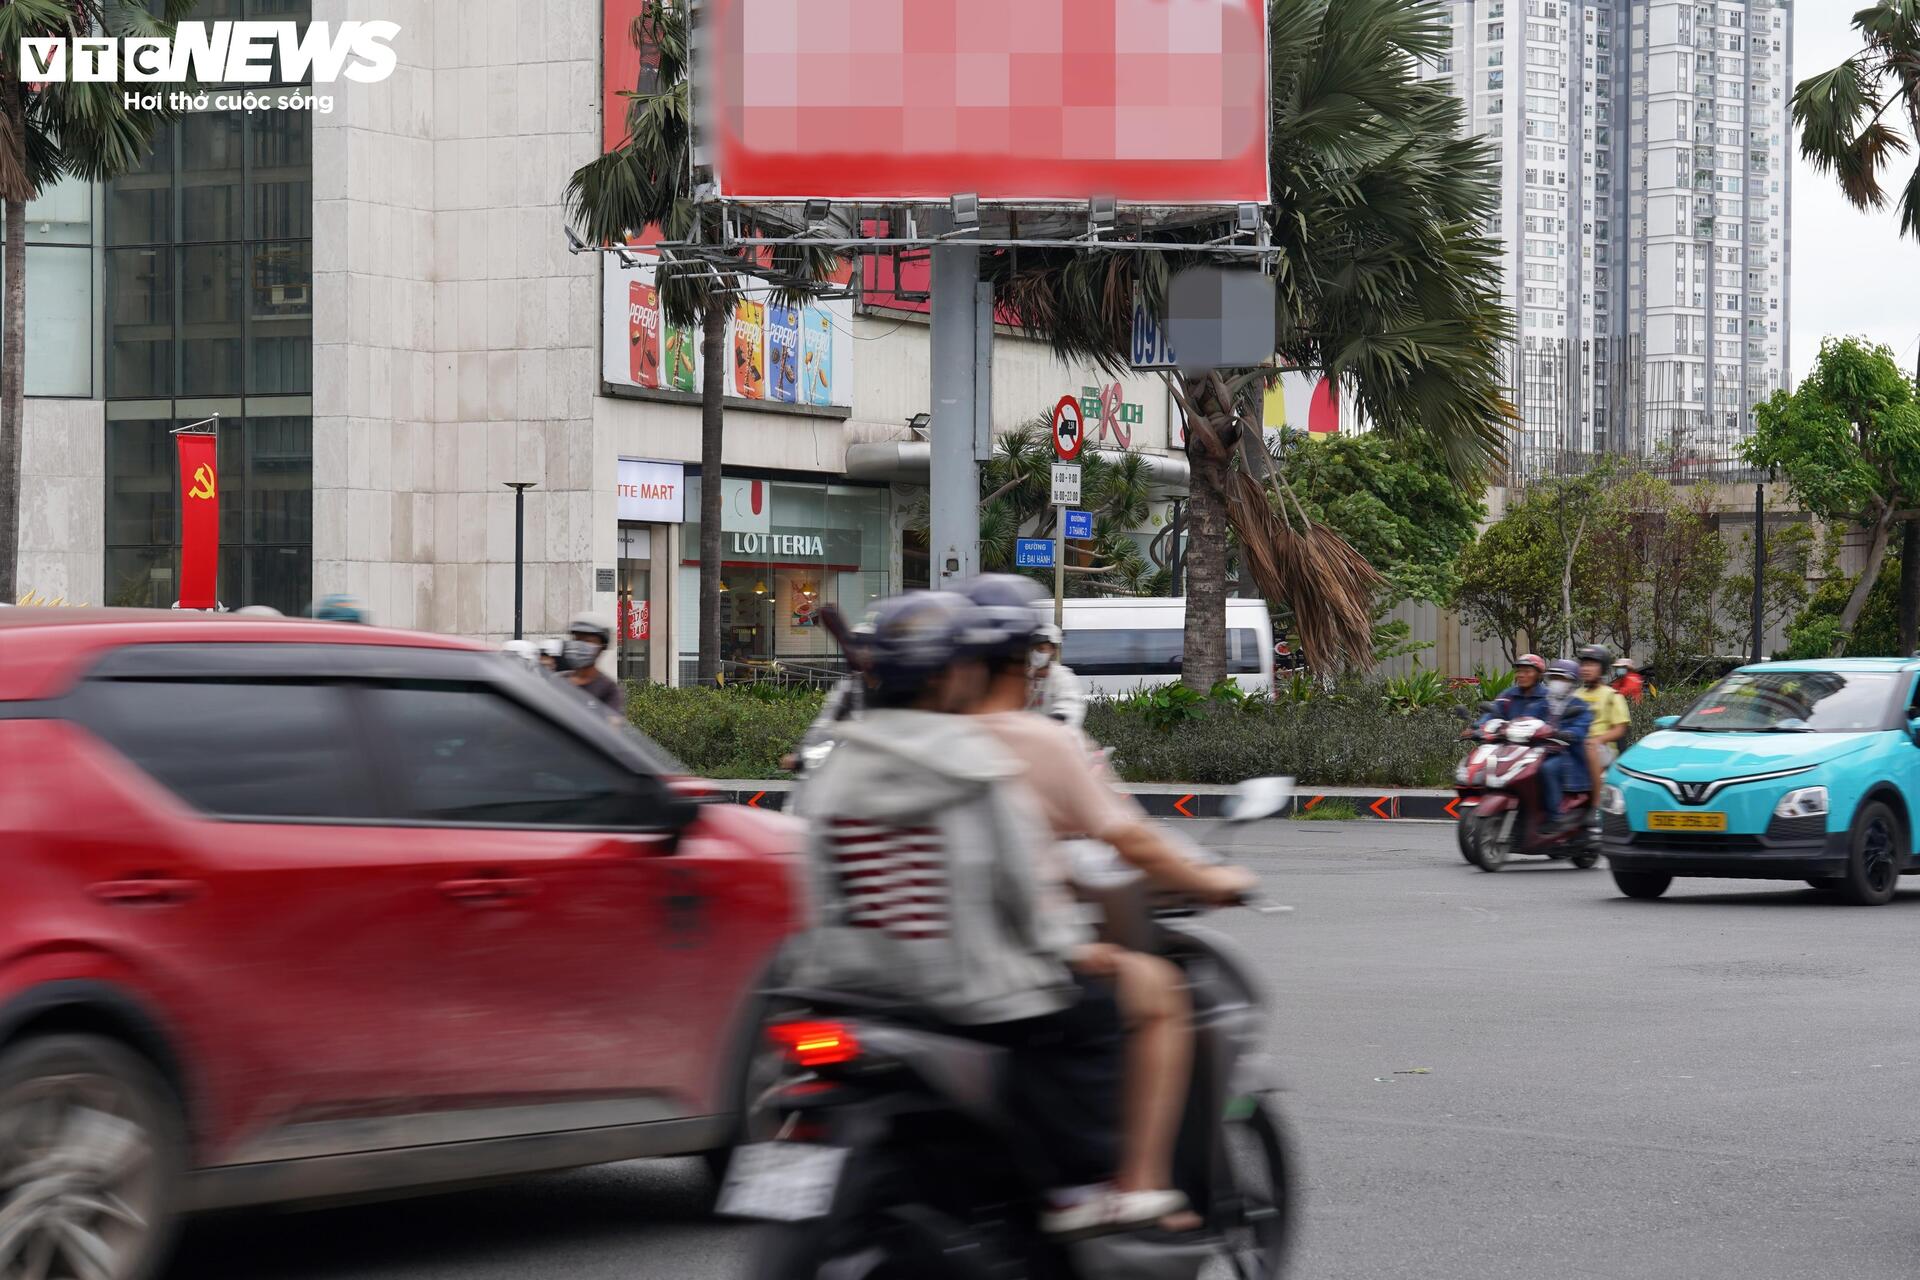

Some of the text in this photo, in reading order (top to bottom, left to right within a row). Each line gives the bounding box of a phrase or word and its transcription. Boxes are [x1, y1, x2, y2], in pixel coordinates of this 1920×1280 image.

[630, 303, 657, 330] PEPERO
[770, 323, 798, 349] PEPERO
[641, 483, 675, 500] MART
[734, 532, 824, 556] LOTTERIA
[1024, 542, 1047, 551] ĐƯỜNG
